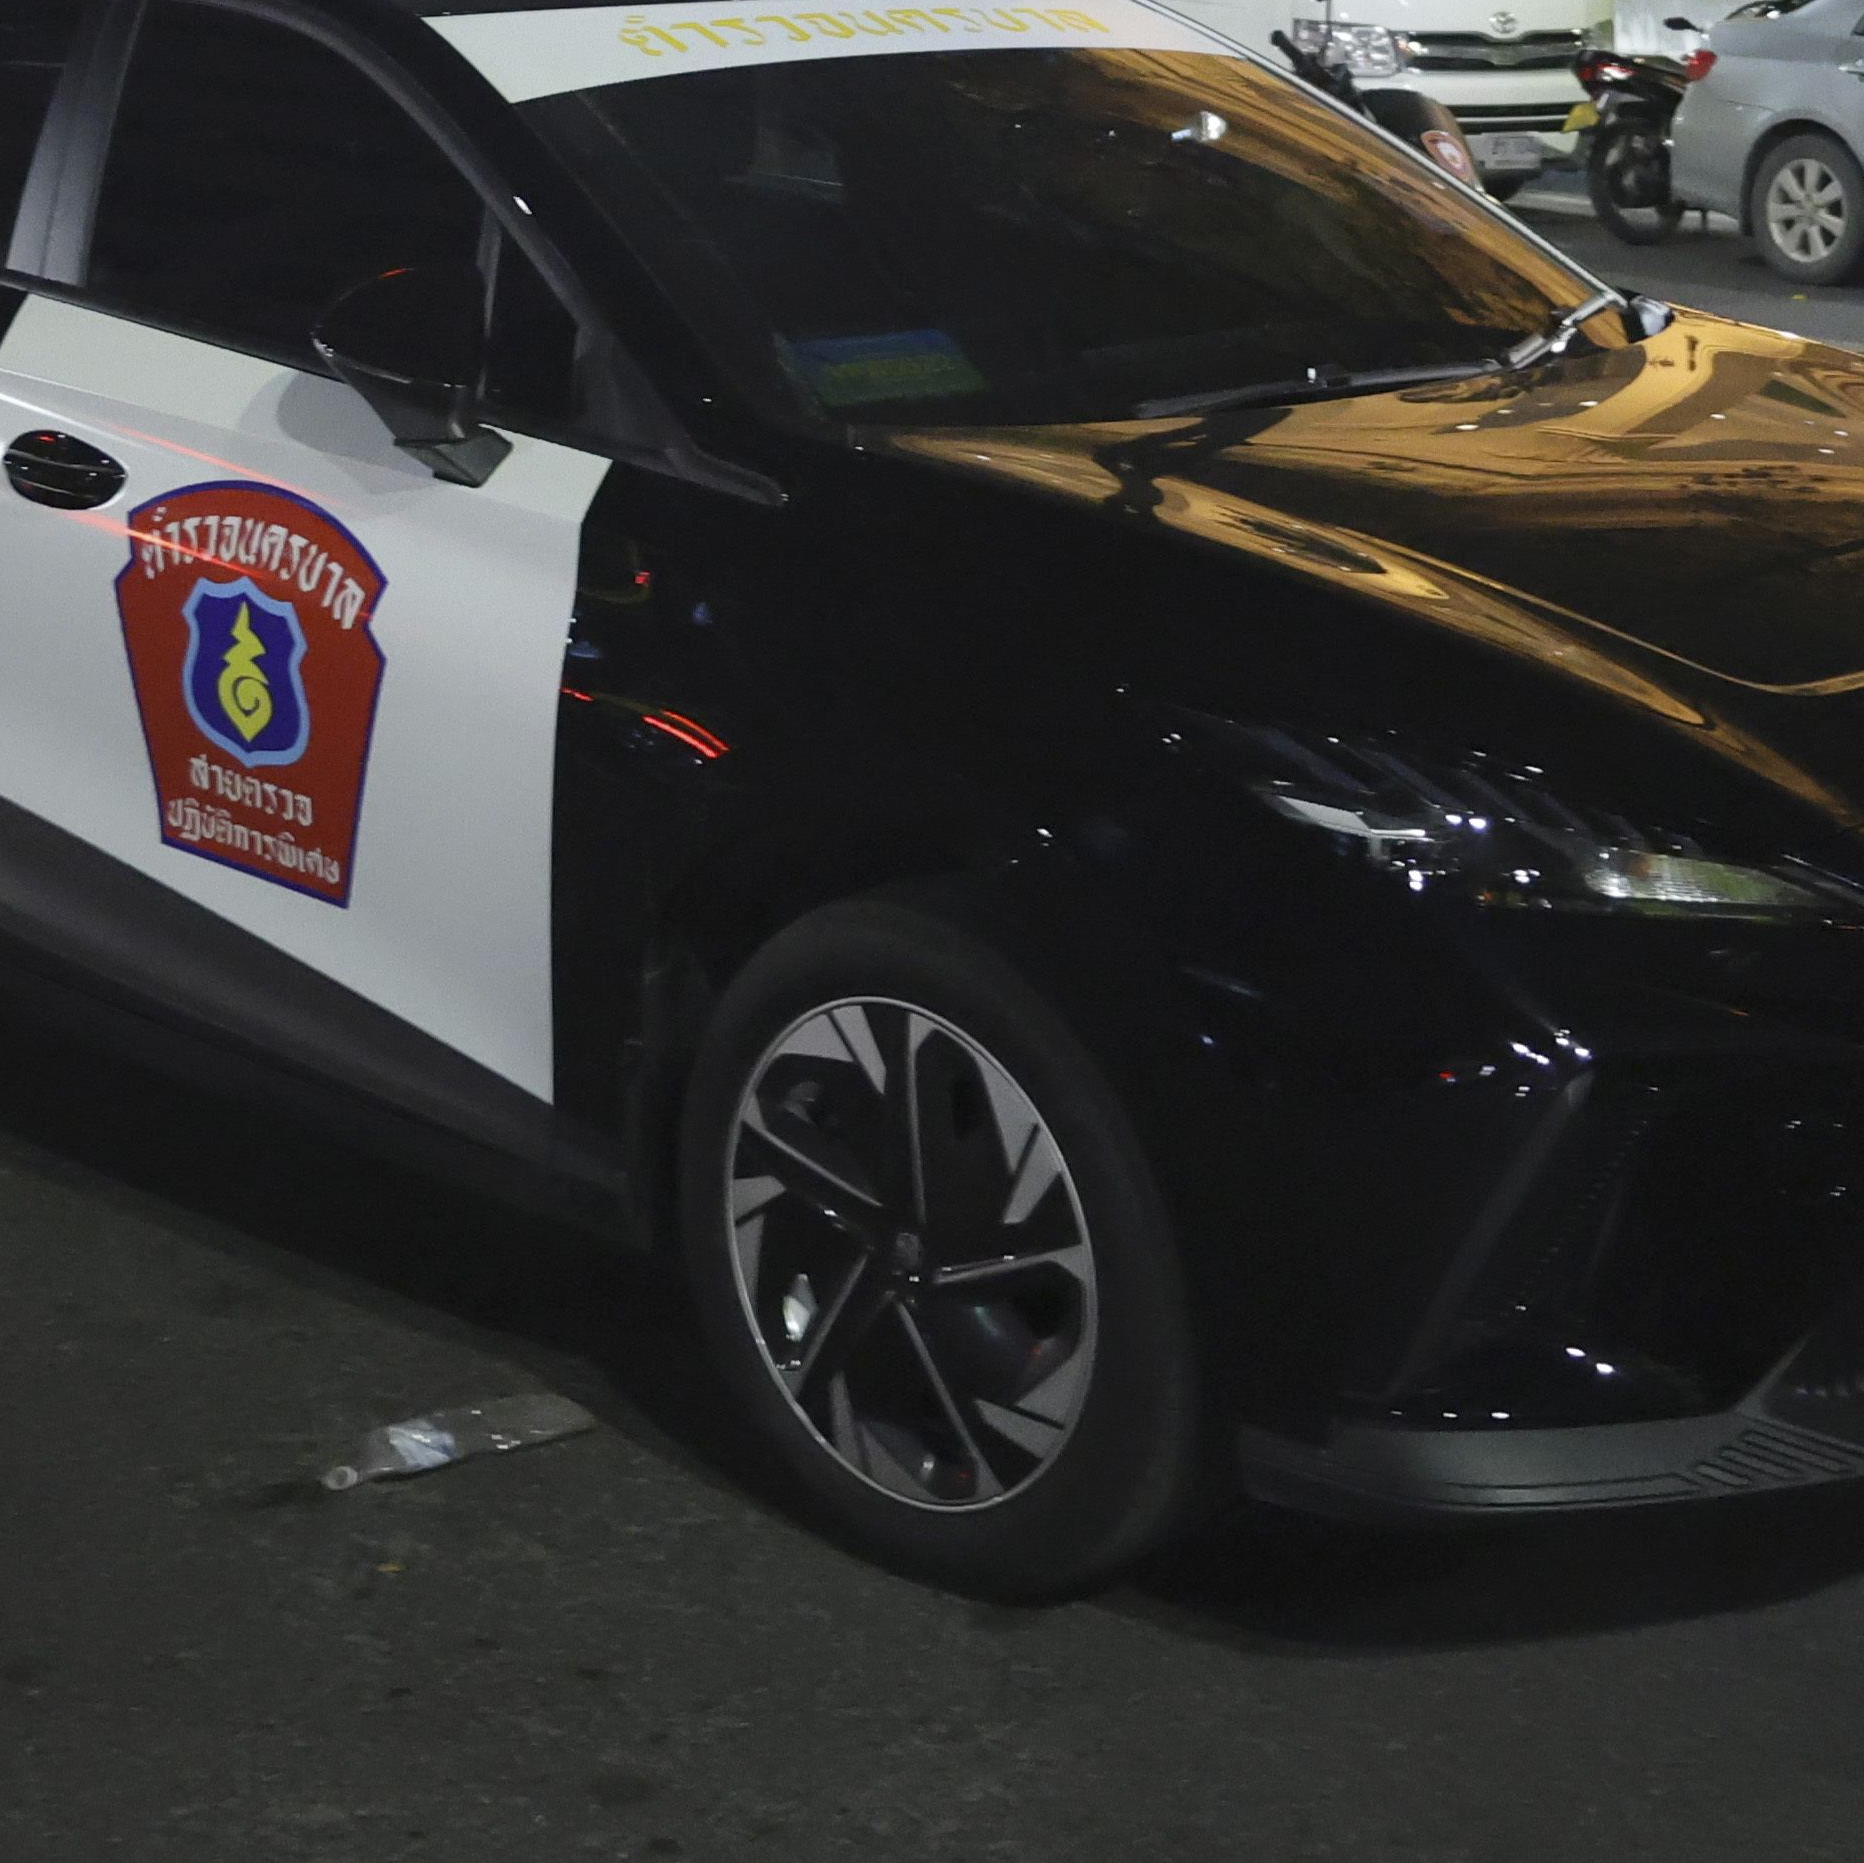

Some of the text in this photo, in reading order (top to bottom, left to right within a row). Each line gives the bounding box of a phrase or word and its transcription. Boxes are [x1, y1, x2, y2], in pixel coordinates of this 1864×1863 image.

[617, 8, 1111, 57] ตำรวจนครบาล
[141, 506, 366, 630] ตำรวจนครบาล
[189, 753, 314, 827] สายตรวจ
[167, 797, 341, 884] ปฏิบัติการพิเศษ
